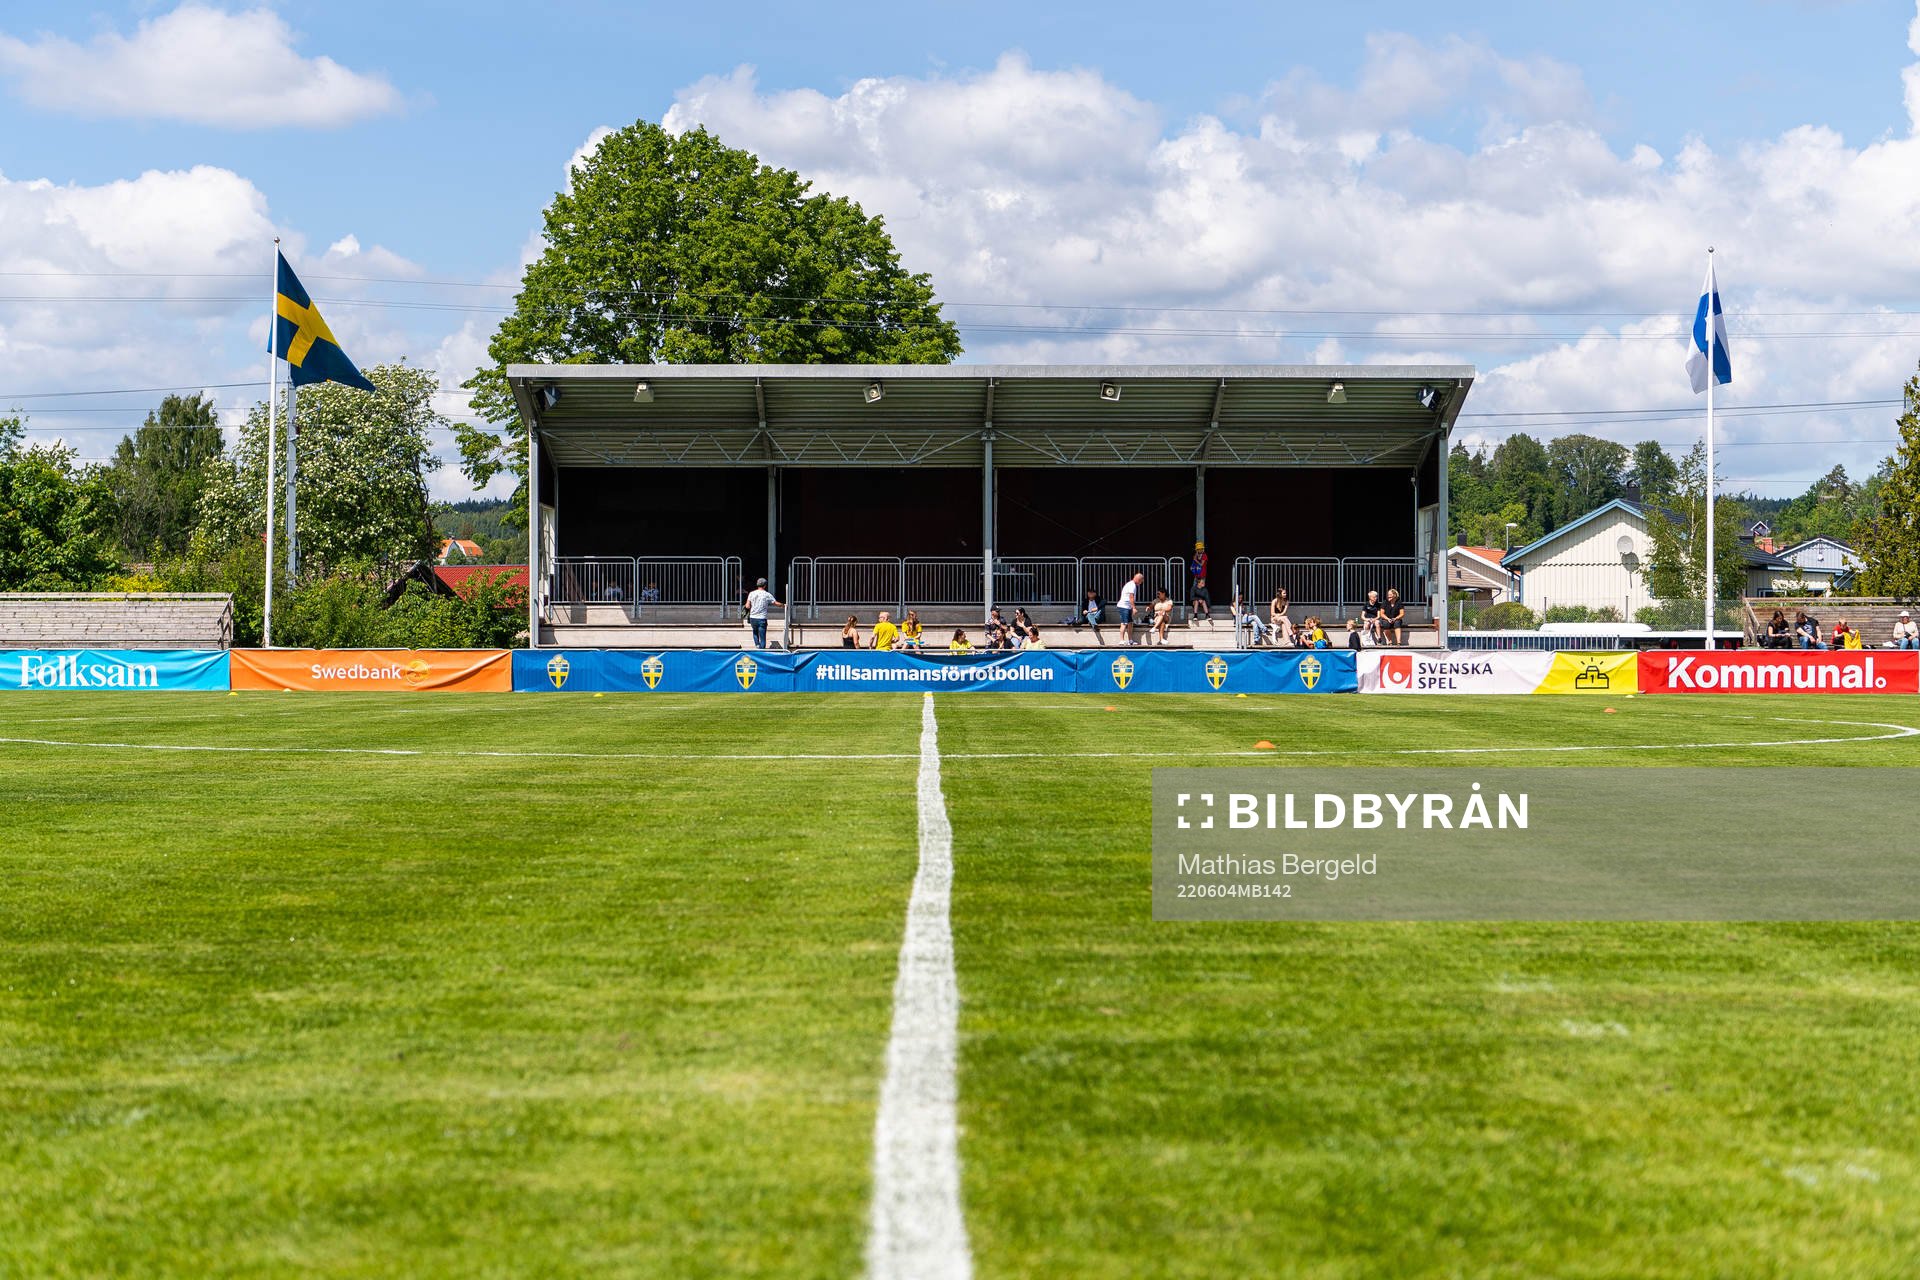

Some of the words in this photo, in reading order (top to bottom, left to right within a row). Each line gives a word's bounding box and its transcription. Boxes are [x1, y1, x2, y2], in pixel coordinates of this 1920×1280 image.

[18, 656, 159, 687] Folksam
[311, 664, 401, 679] Swedbank
[816, 664, 1054, 682] #tillsammansförfotbollen
[1418, 661, 1493, 675] SVENSKA
[1418, 676, 1457, 690] SPEL
